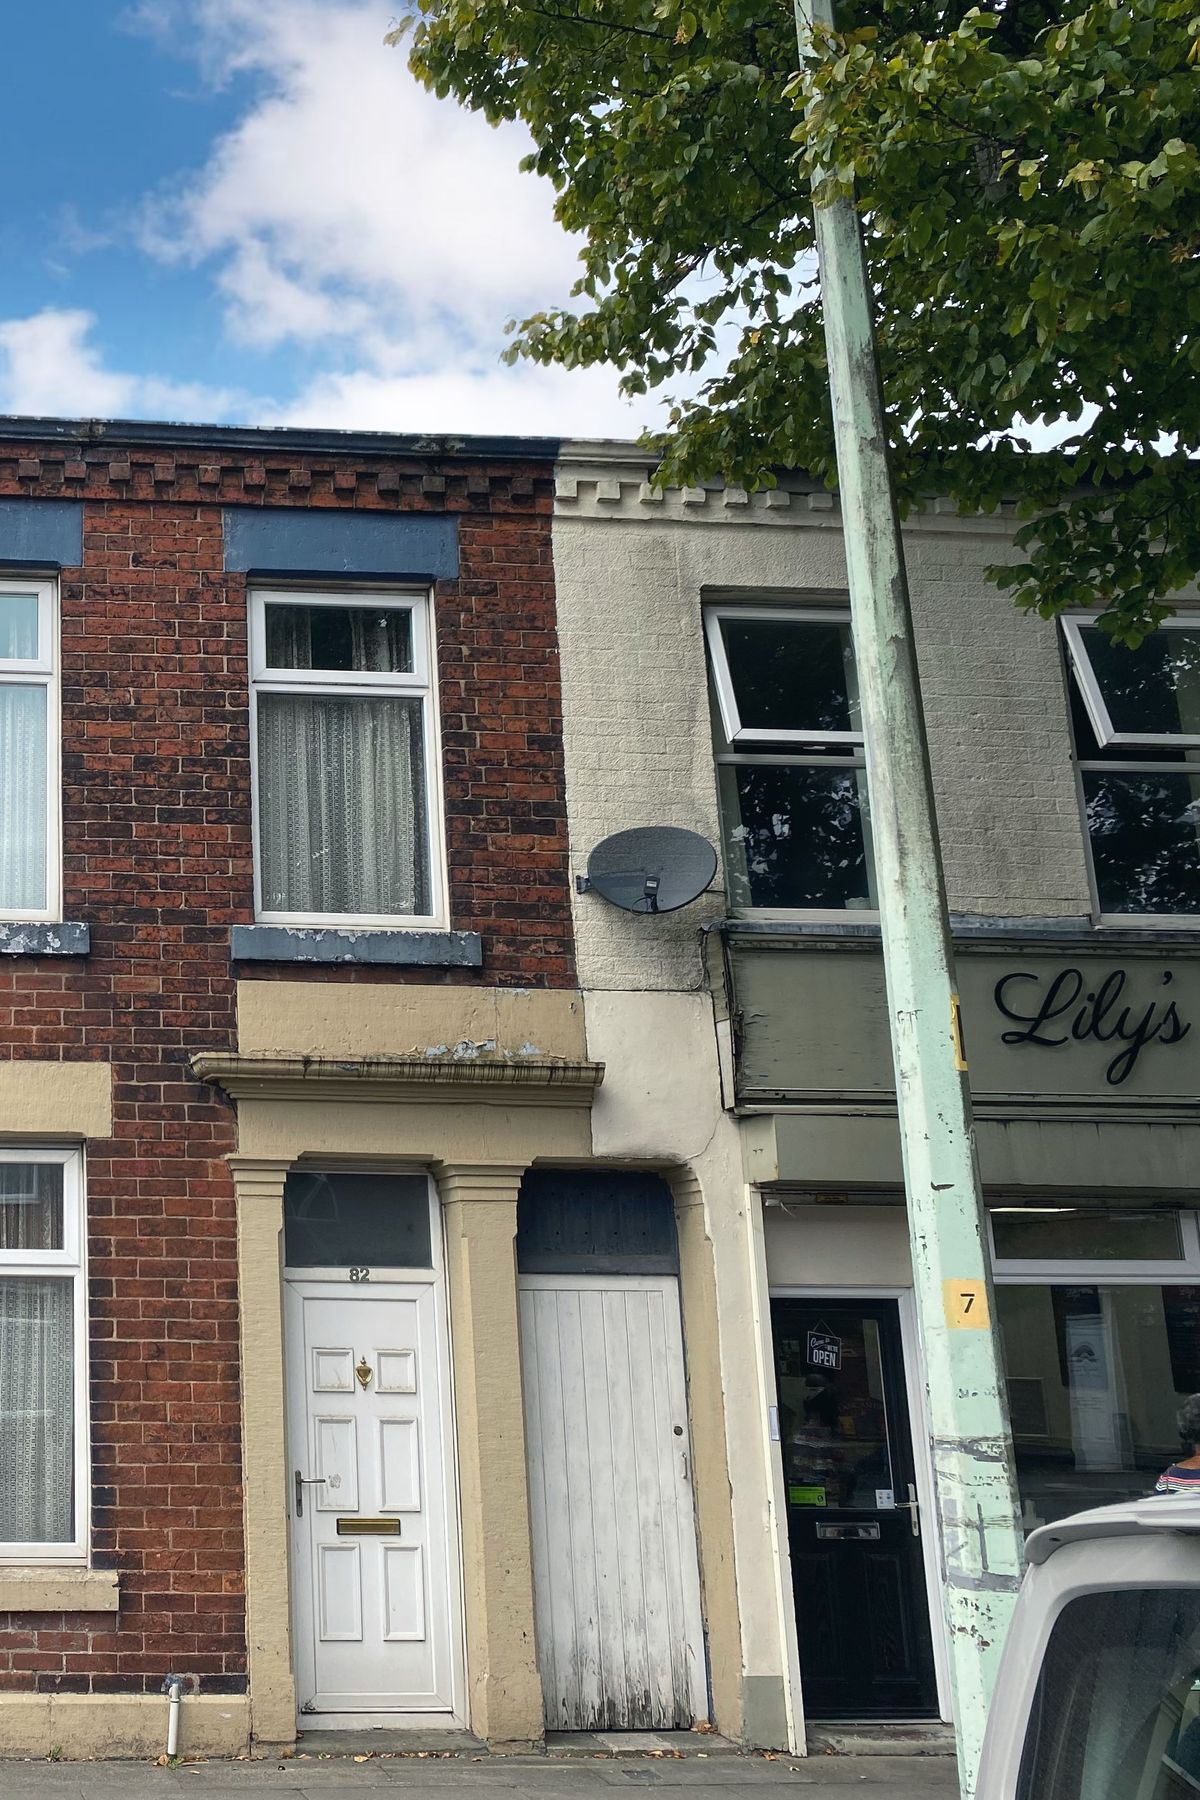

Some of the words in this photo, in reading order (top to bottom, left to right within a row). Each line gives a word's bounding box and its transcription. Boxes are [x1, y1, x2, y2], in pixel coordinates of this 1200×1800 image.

[994, 968, 1191, 1085] Lily's
[349, 1267, 370, 1281] 82
[960, 1293, 975, 1314] 7
[813, 1349, 836, 1367] OPEN
